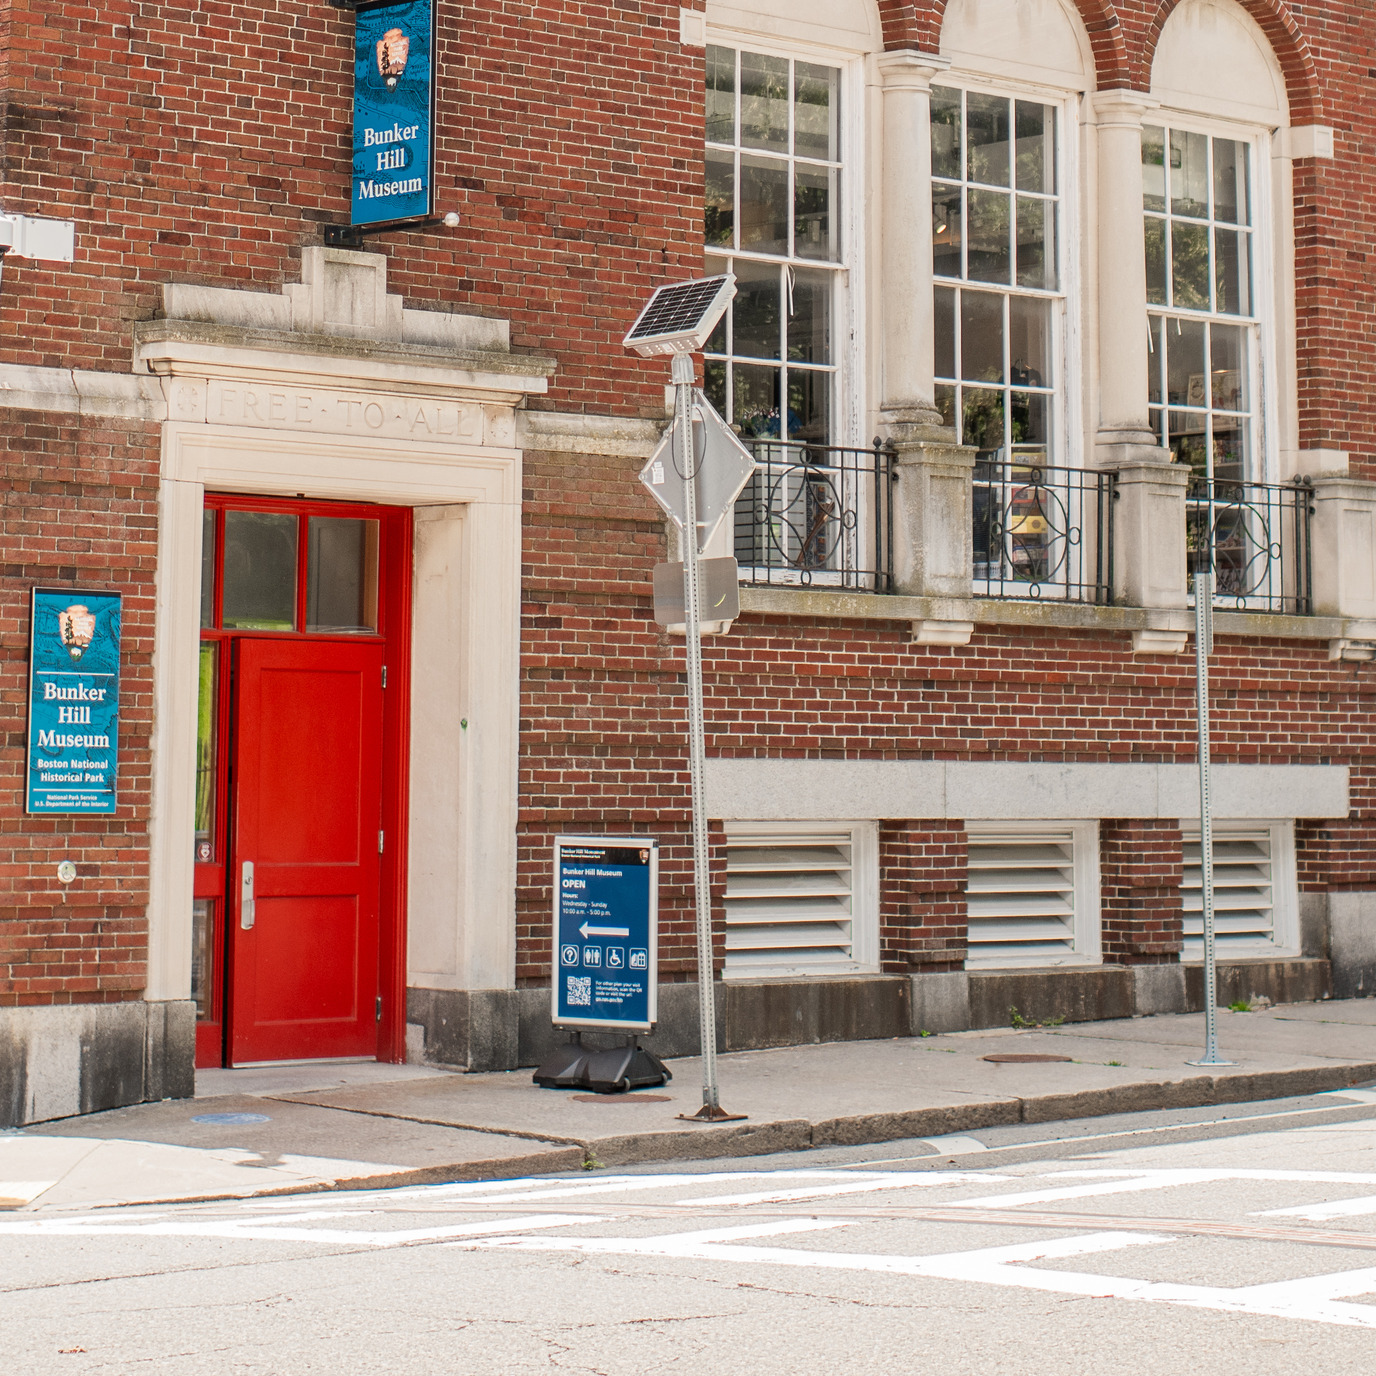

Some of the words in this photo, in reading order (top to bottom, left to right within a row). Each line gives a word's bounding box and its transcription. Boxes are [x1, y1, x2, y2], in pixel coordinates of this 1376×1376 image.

[363, 122, 420, 147] Bunker
[376, 147, 406, 172] Hill
[358, 176, 423, 200] Museum
[217, 388, 314, 424] FREE
[336, 398, 385, 430] TO
[409, 406, 474, 437] ALL
[43, 682, 107, 701] Bunker
[57, 706, 92, 724] Hill
[37, 729, 111, 748] Museum
[37, 758, 69, 769] Boston
[70, 759, 109, 770] National
[40, 772, 83, 783] Historical
[85, 773, 105, 783] Park
[562, 867, 584, 876] Bunker
[584, 868, 596, 876] Hill
[596, 869, 623, 877] Museum
[561, 879, 586, 889] OPEN
[562, 900, 588, 909] Wednesday
[590, 901, 608, 909] Sunday
